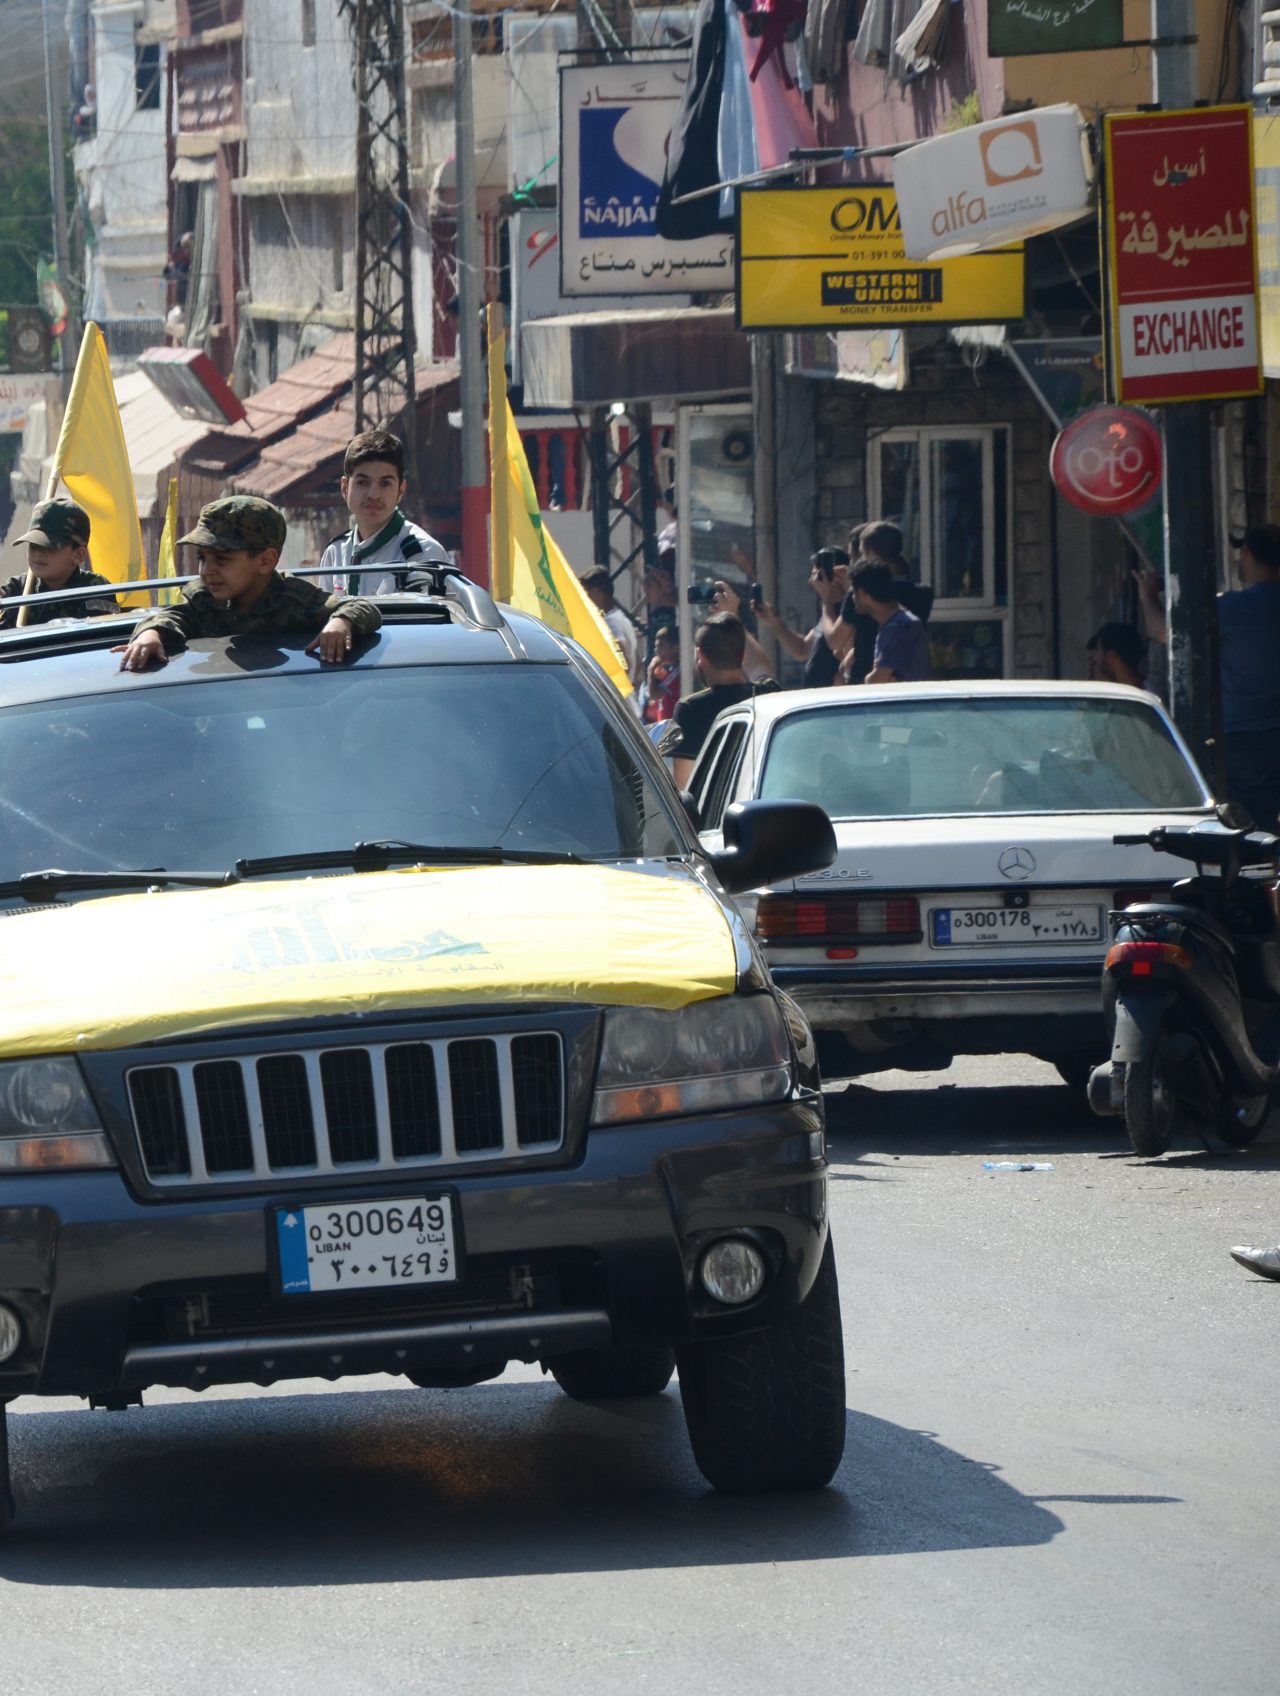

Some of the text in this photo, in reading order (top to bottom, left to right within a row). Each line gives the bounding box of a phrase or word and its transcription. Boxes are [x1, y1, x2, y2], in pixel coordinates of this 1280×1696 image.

[830, 197, 902, 233] OM
[932, 191, 988, 238] alfa
[1118, 208, 1250, 268] للصيرفة
[827, 273, 918, 288] WESTERN
[855, 287, 918, 302] UNION
[840, 304, 933, 315] MONEY TRANSFER
[1133, 306, 1244, 356] EXCHANGE
[964, 911, 1030, 928] 300178
[327, 1204, 445, 1239] 300649
[315, 1242, 351, 1254] LIBAN
[416, 1232, 446, 1246] لبنان
[331, 1251, 431, 1283] ٣٠٠٦٤٩
